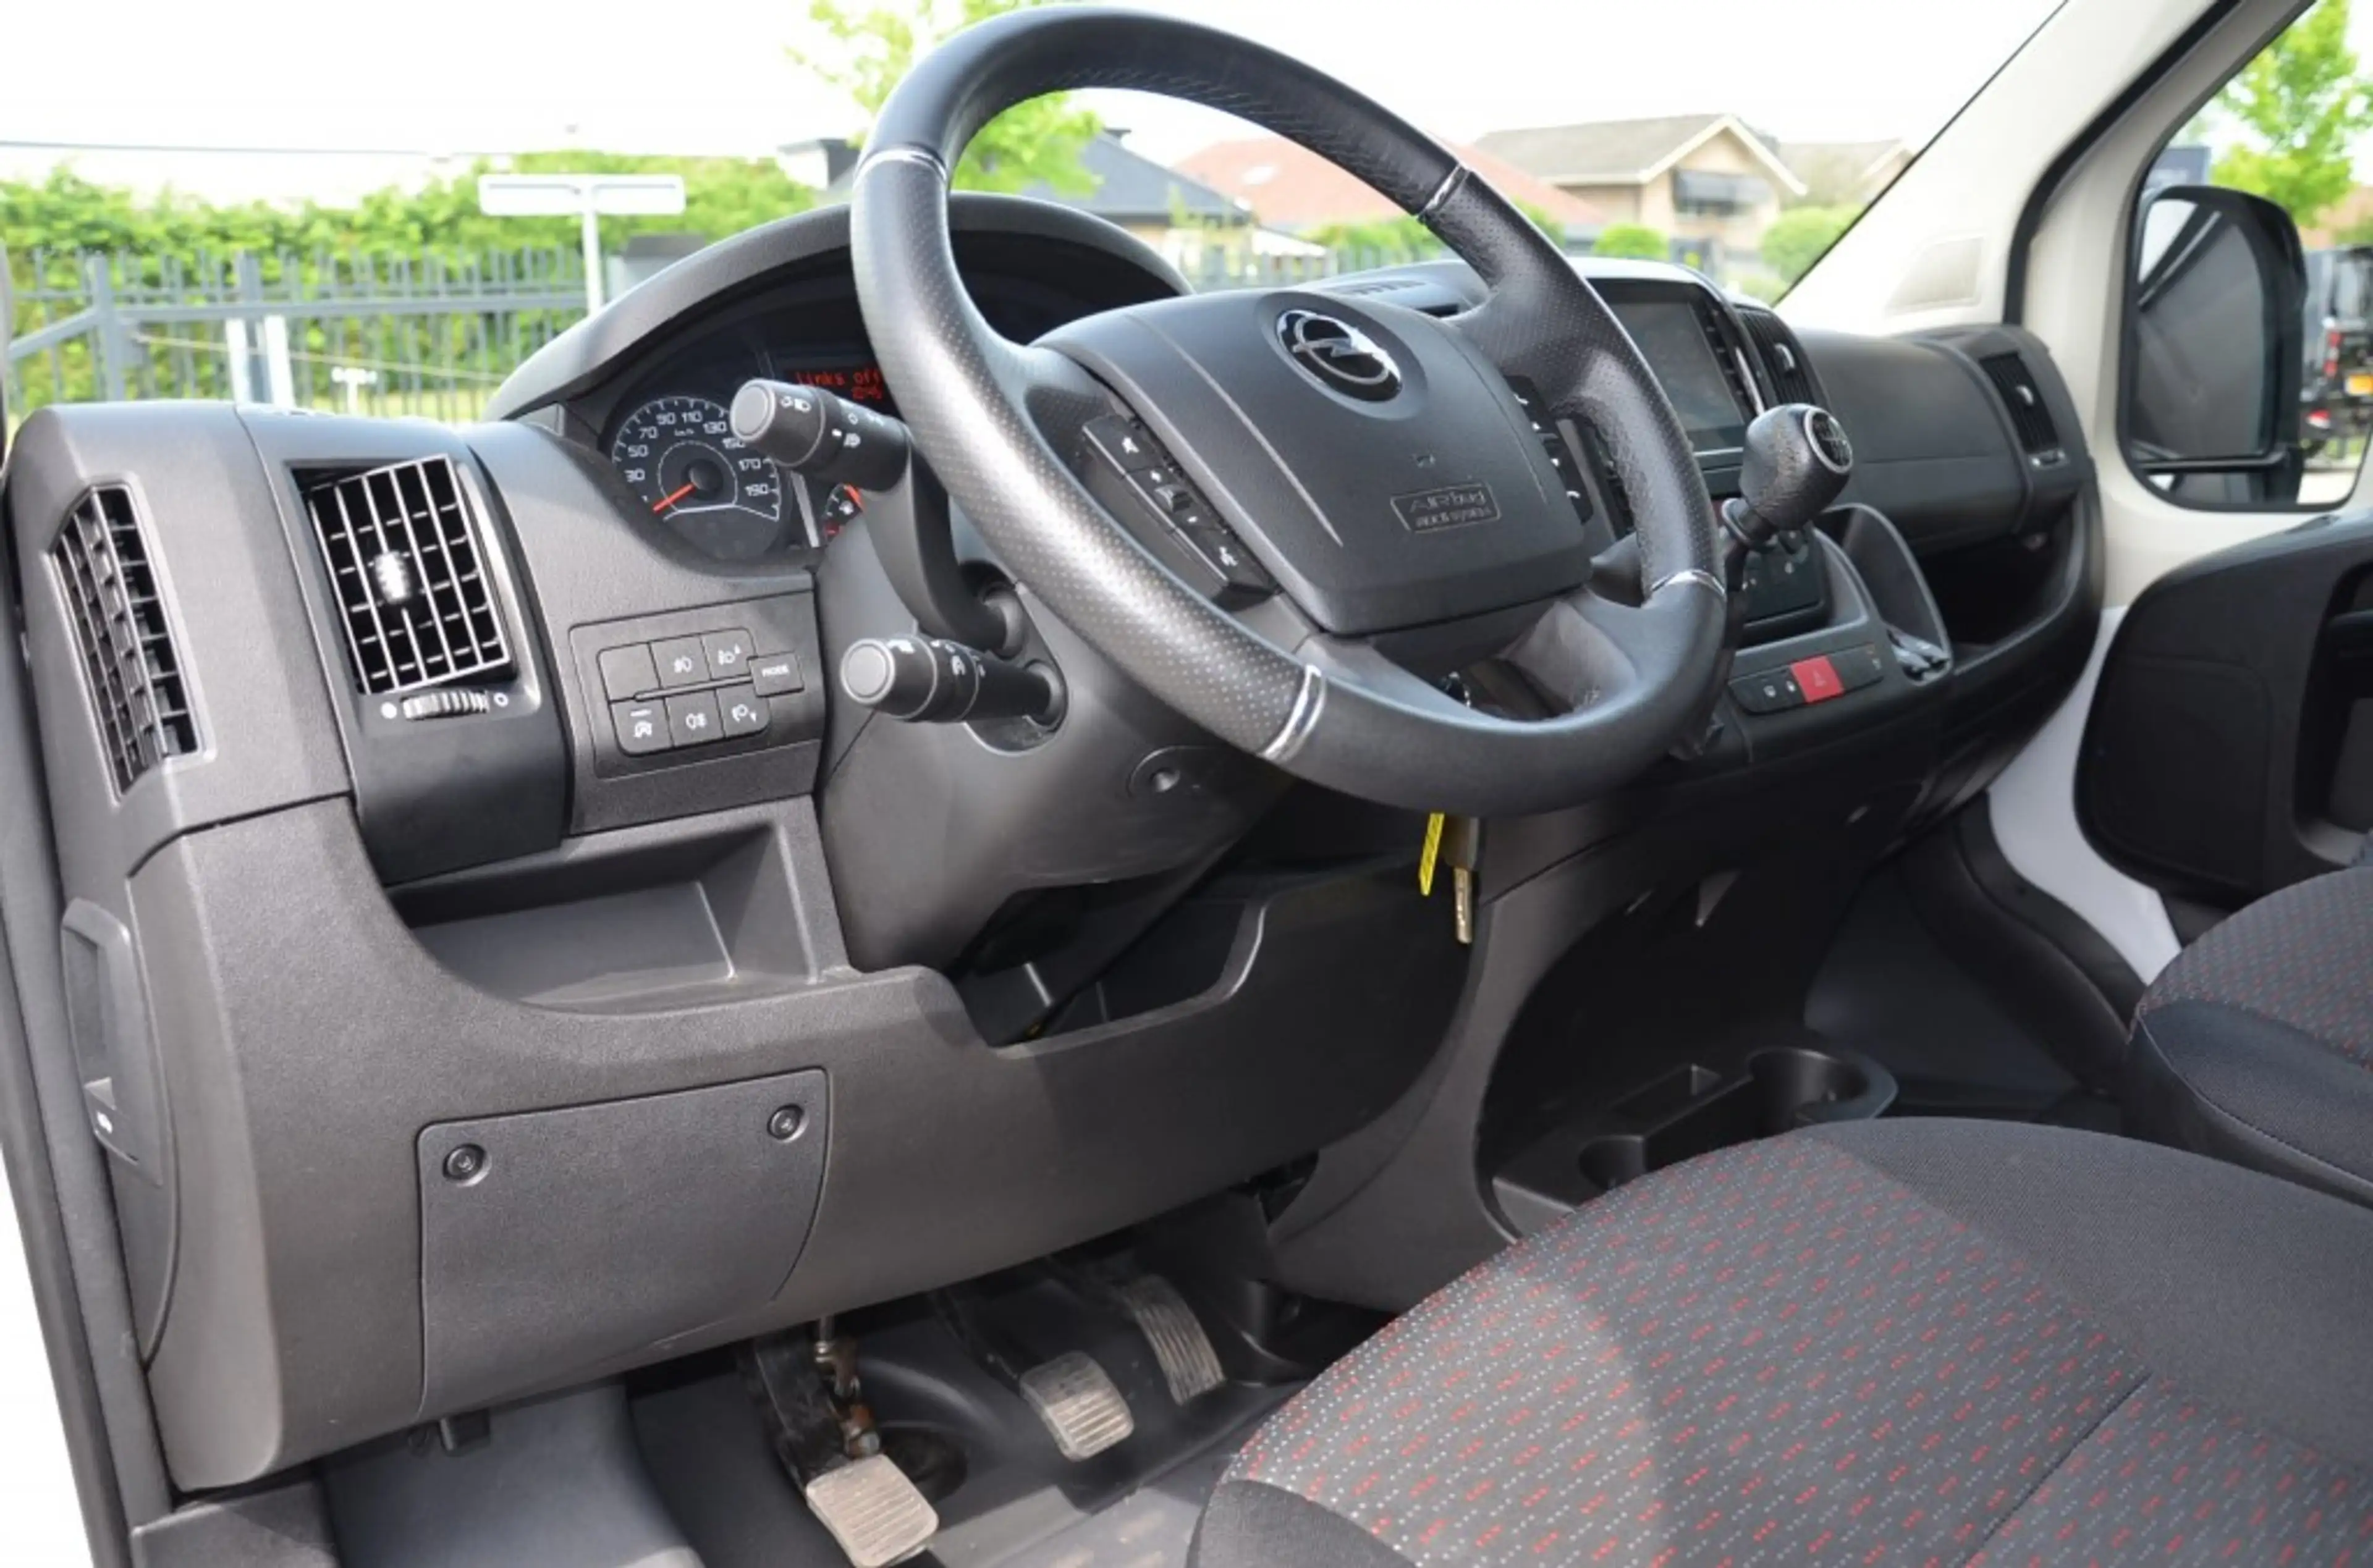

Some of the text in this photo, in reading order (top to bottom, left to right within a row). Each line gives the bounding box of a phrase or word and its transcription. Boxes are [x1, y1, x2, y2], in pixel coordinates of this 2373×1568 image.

[681, 410, 703, 424] 110
[638, 426, 659, 440] 70
[703, 421, 727, 434] 130
[627, 444, 649, 458] 50
[738, 458, 761, 471] 170
[624, 468, 646, 483] 30
[745, 484, 769, 496] 190
